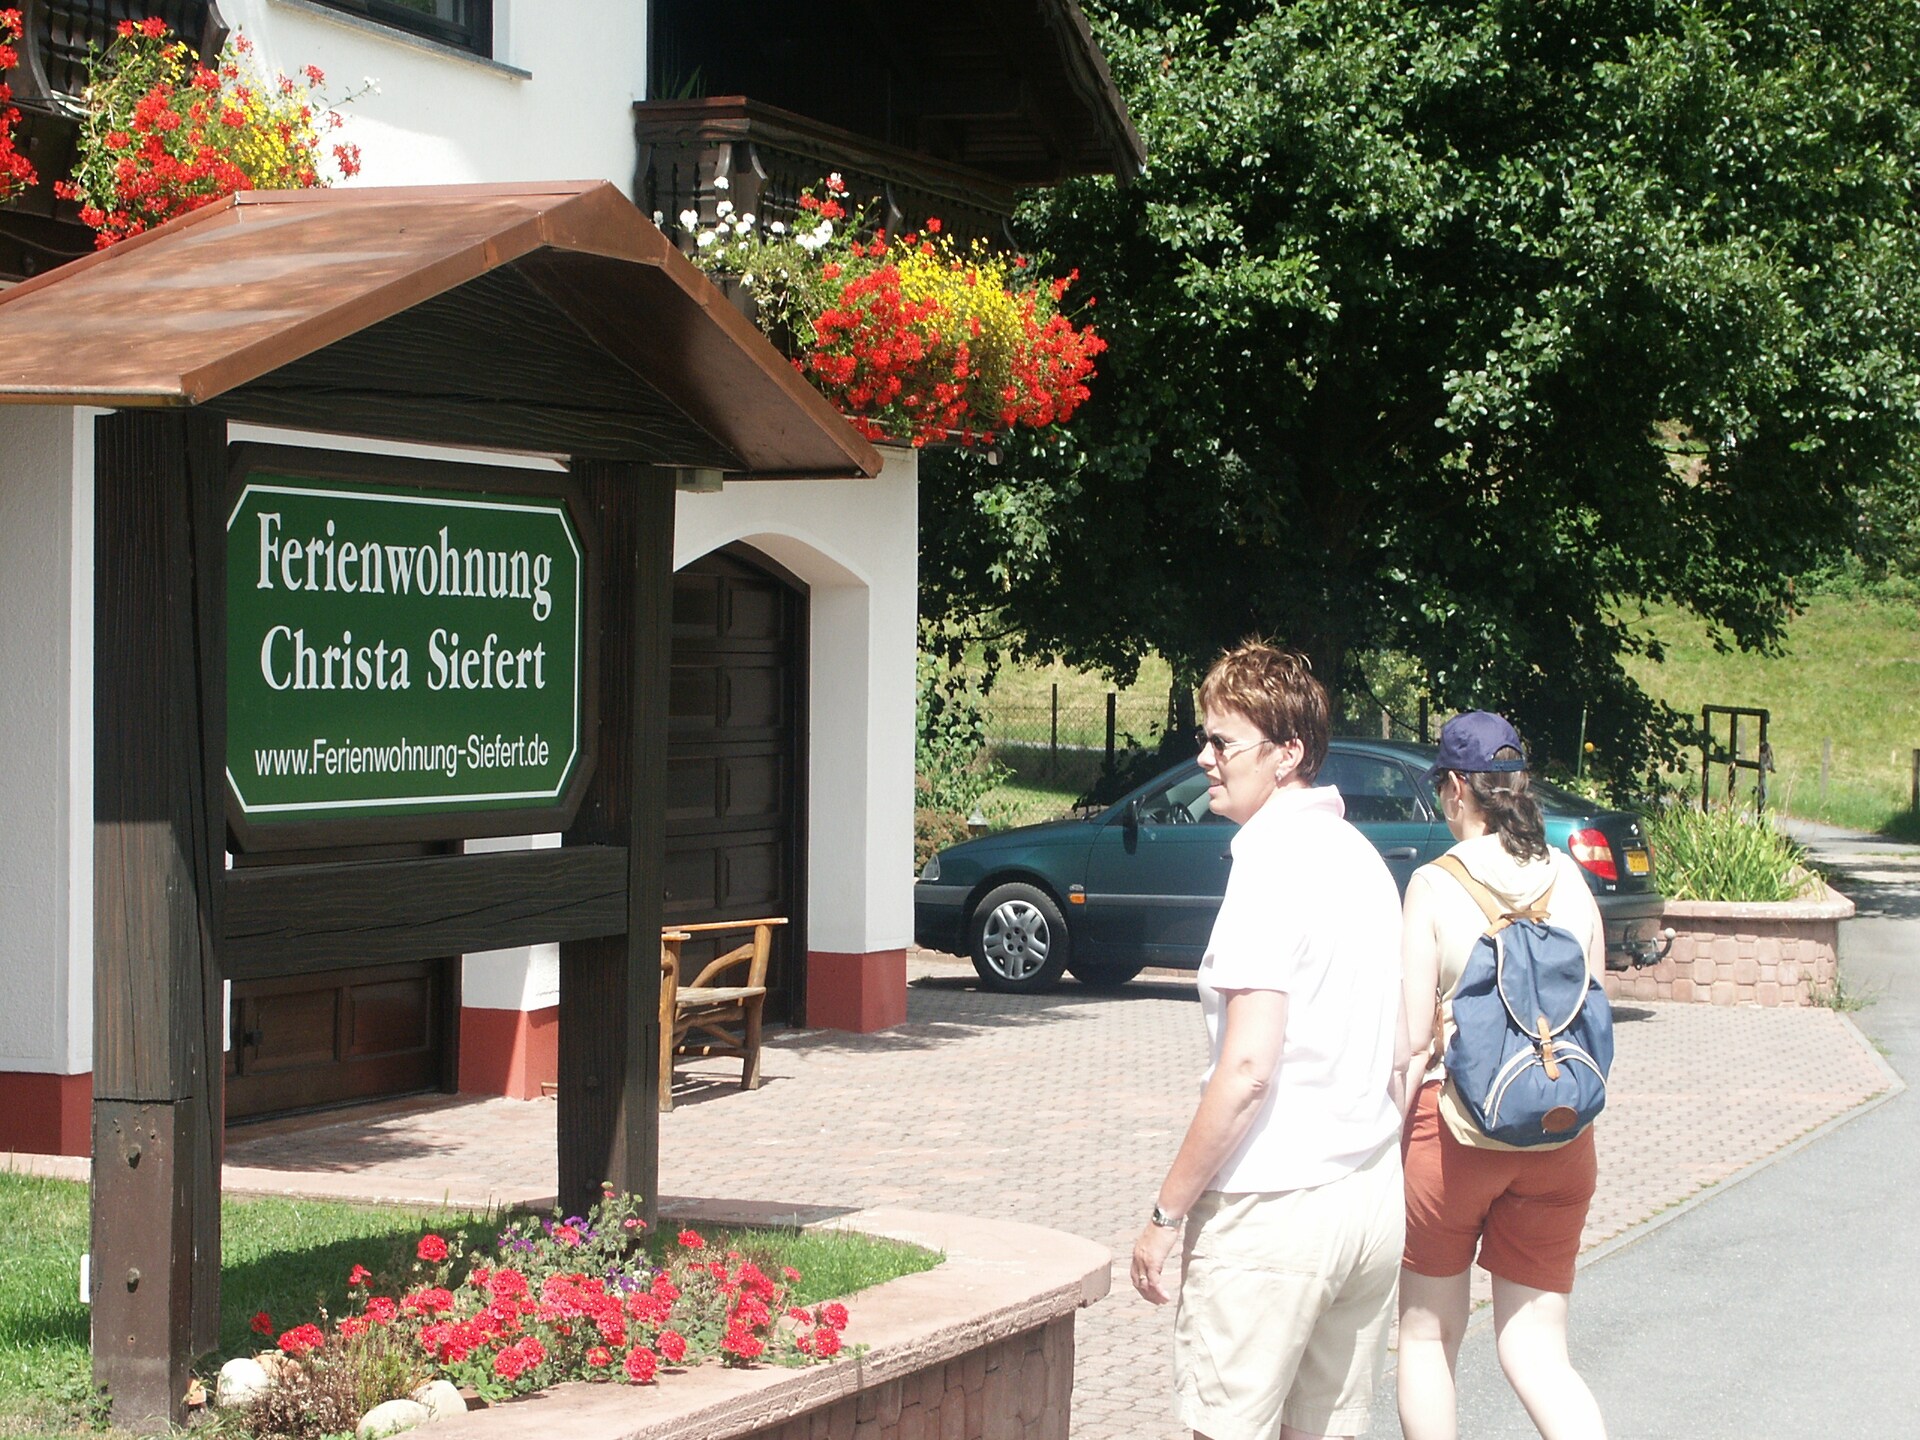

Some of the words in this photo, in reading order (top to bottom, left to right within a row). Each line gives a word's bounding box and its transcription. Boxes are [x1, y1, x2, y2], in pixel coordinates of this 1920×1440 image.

[256, 512, 552, 622] Ferienwohnung
[260, 625, 410, 691] Christa
[427, 628, 546, 690] Siefert
[254, 733, 549, 777] www.Ferienwohnung-Siefert.de
